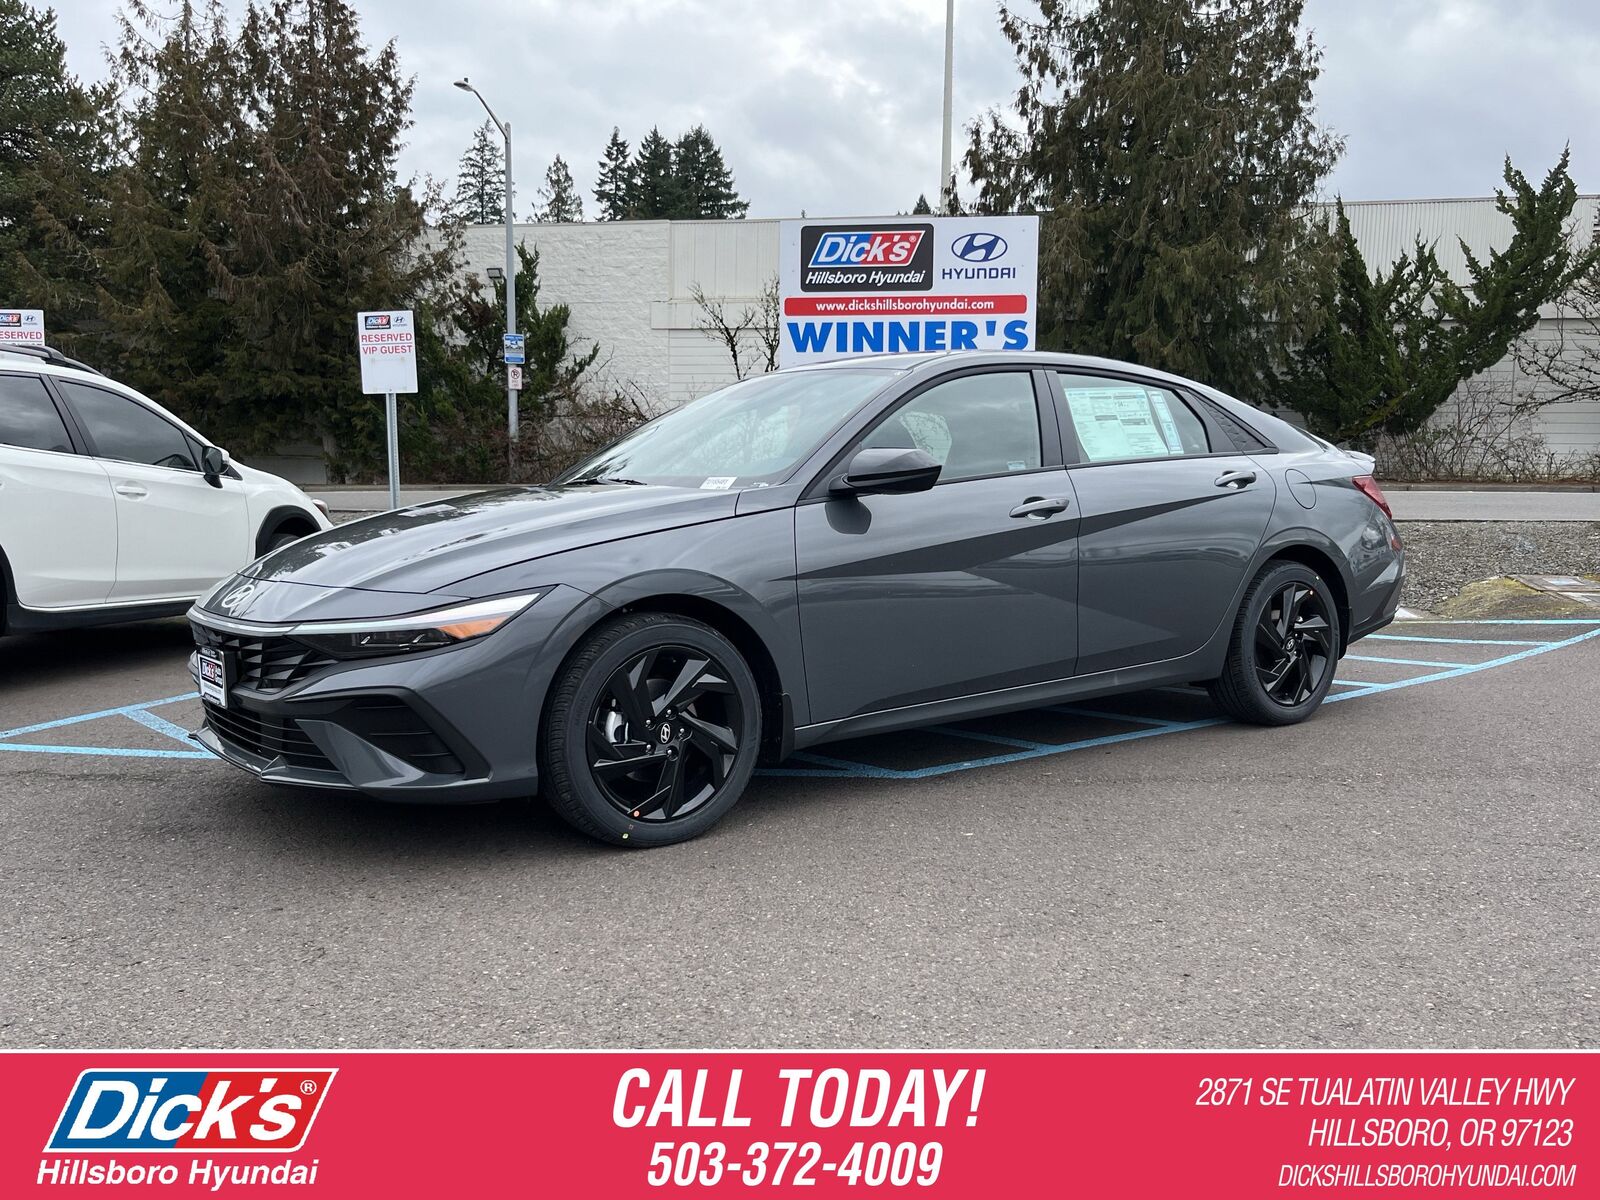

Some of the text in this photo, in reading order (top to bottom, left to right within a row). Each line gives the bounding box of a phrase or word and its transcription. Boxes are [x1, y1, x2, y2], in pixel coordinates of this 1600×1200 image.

[817, 234, 911, 263] Dick's
[805, 270, 926, 287] Hillsboro Hyundai
[941, 267, 1016, 280] HYUNDAI
[815, 297, 995, 313] www.dickshillsborohyundai.com
[0, 331, 42, 340] ESERVED
[361, 332, 412, 343] RESERVED
[786, 319, 1029, 353] WINNER'S
[362, 345, 412, 355] VIP GUEST
